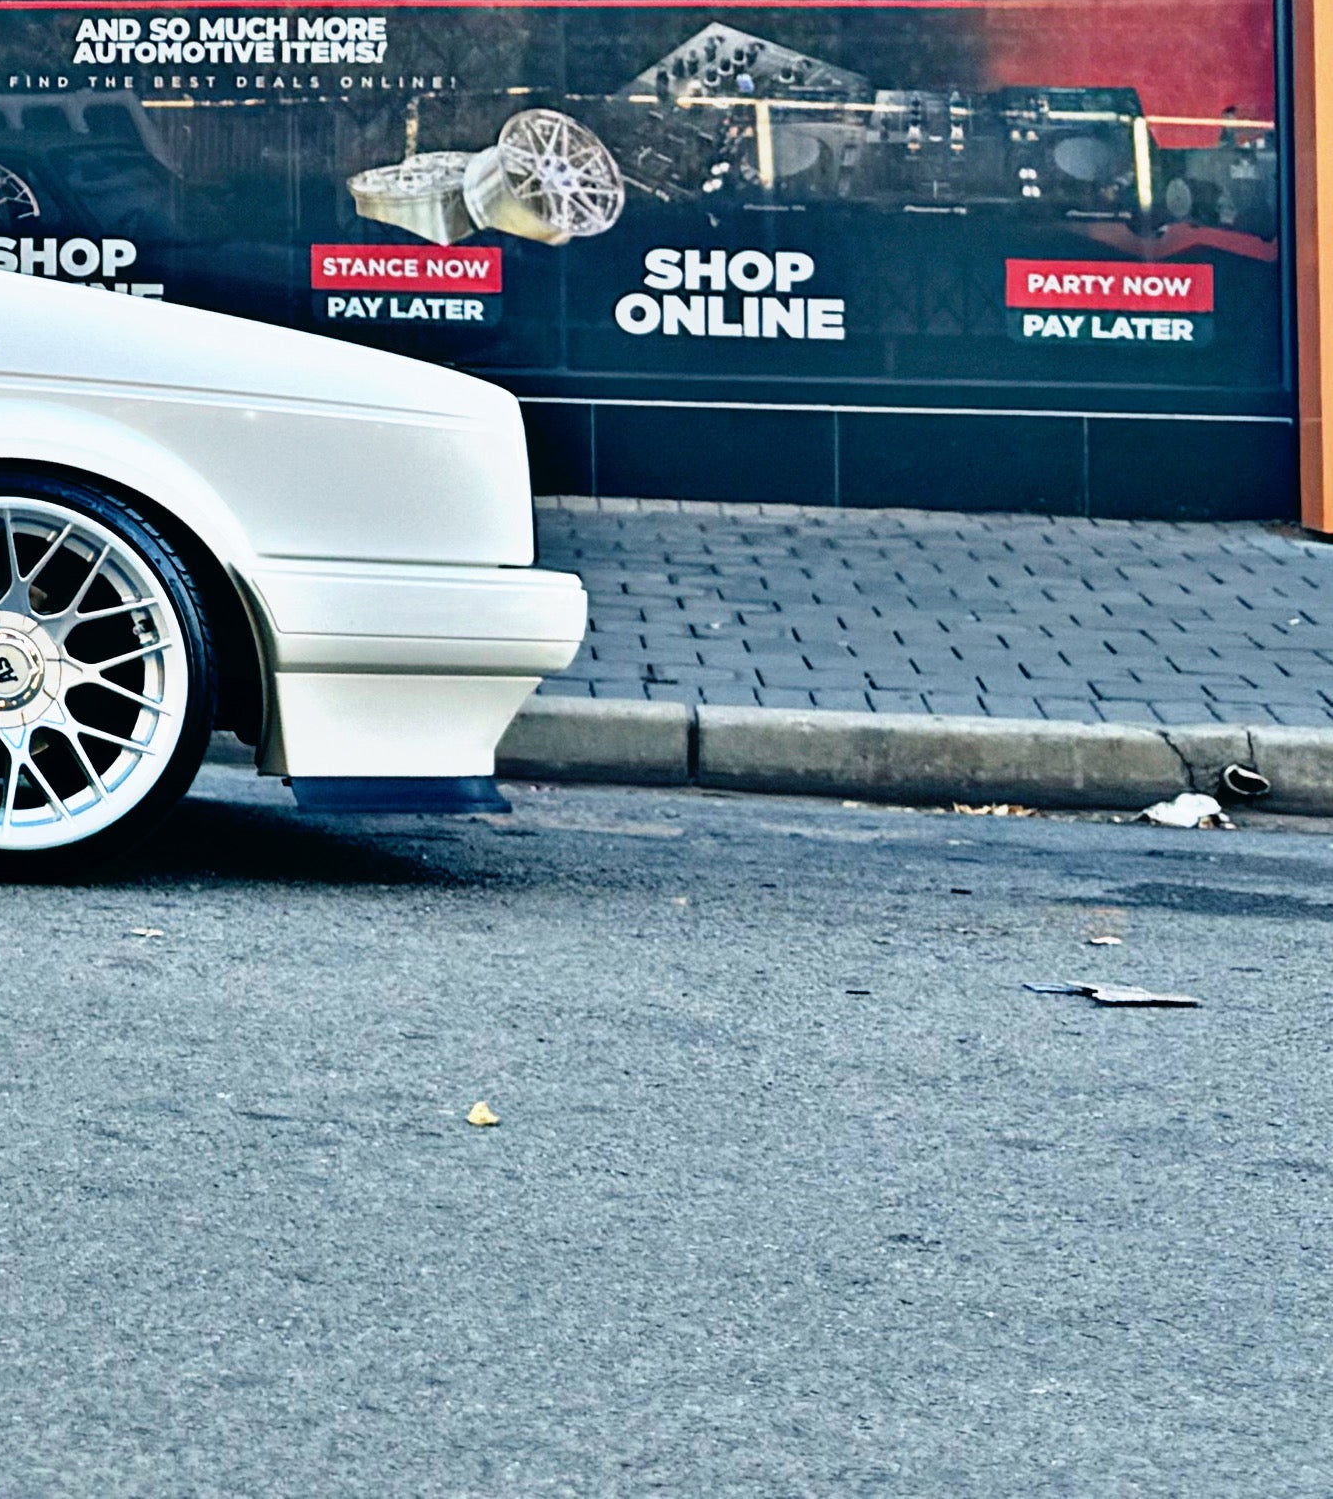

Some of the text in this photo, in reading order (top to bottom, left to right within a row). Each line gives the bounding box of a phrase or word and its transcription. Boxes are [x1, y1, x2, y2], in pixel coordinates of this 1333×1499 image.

[75, 17, 387, 42] AND SO MUCH MORE
[73, 41, 388, 64] AUTOMOTIVE ITEMS!
[9, 74, 458, 90] FIND THE BEST DEALS ONLINE!
[322, 257, 490, 279] STANCE NOW
[643, 249, 814, 294] SHOP
[1027, 274, 1192, 298] PARTY NOW
[327, 297, 484, 321] PAY LATER
[614, 296, 846, 341] ONLINE
[1022, 315, 1194, 342] PAY LATER
